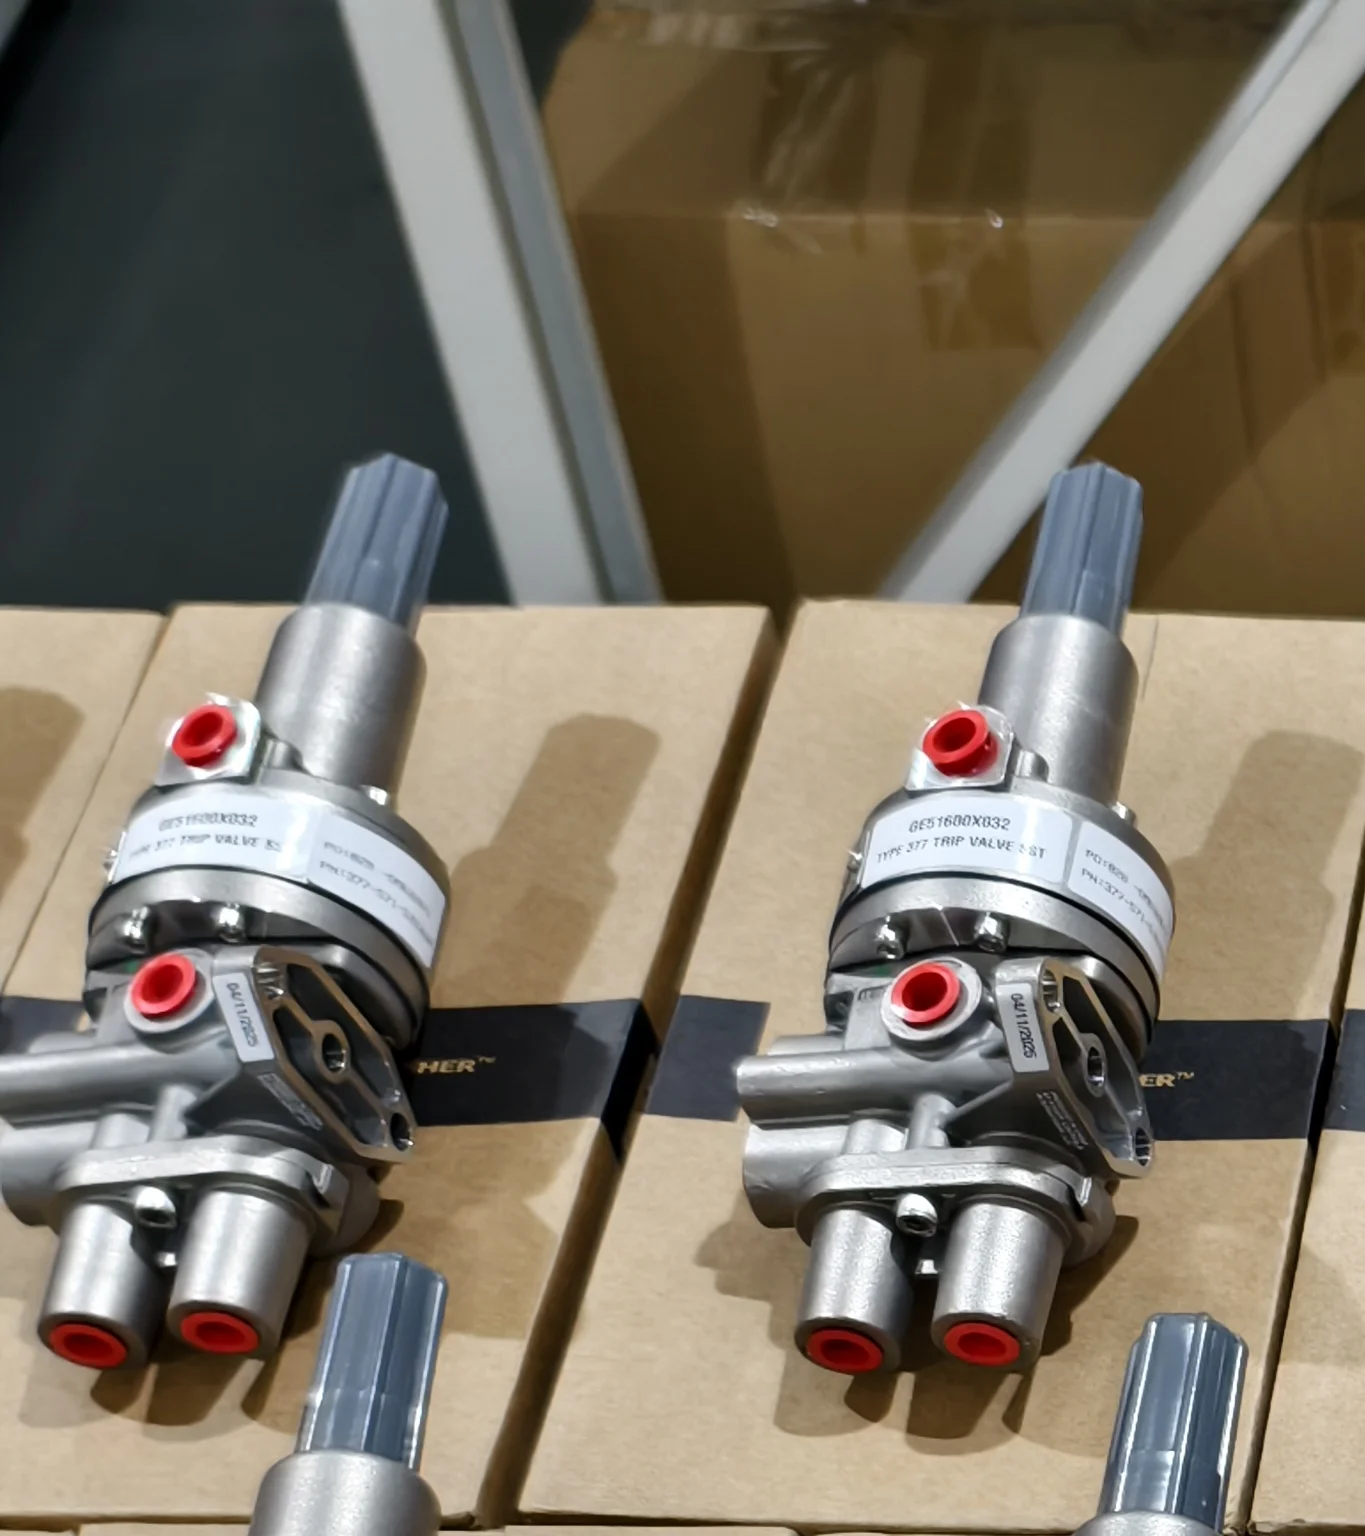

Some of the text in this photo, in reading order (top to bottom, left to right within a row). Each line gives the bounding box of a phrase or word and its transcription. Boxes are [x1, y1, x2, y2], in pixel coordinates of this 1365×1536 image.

[908, 814, 1011, 834] GE51600X032
[933, 835, 965, 849] TRIP
[969, 835, 1016, 852] VALVE
[1010, 992, 1038, 1060] 04/11/2025
